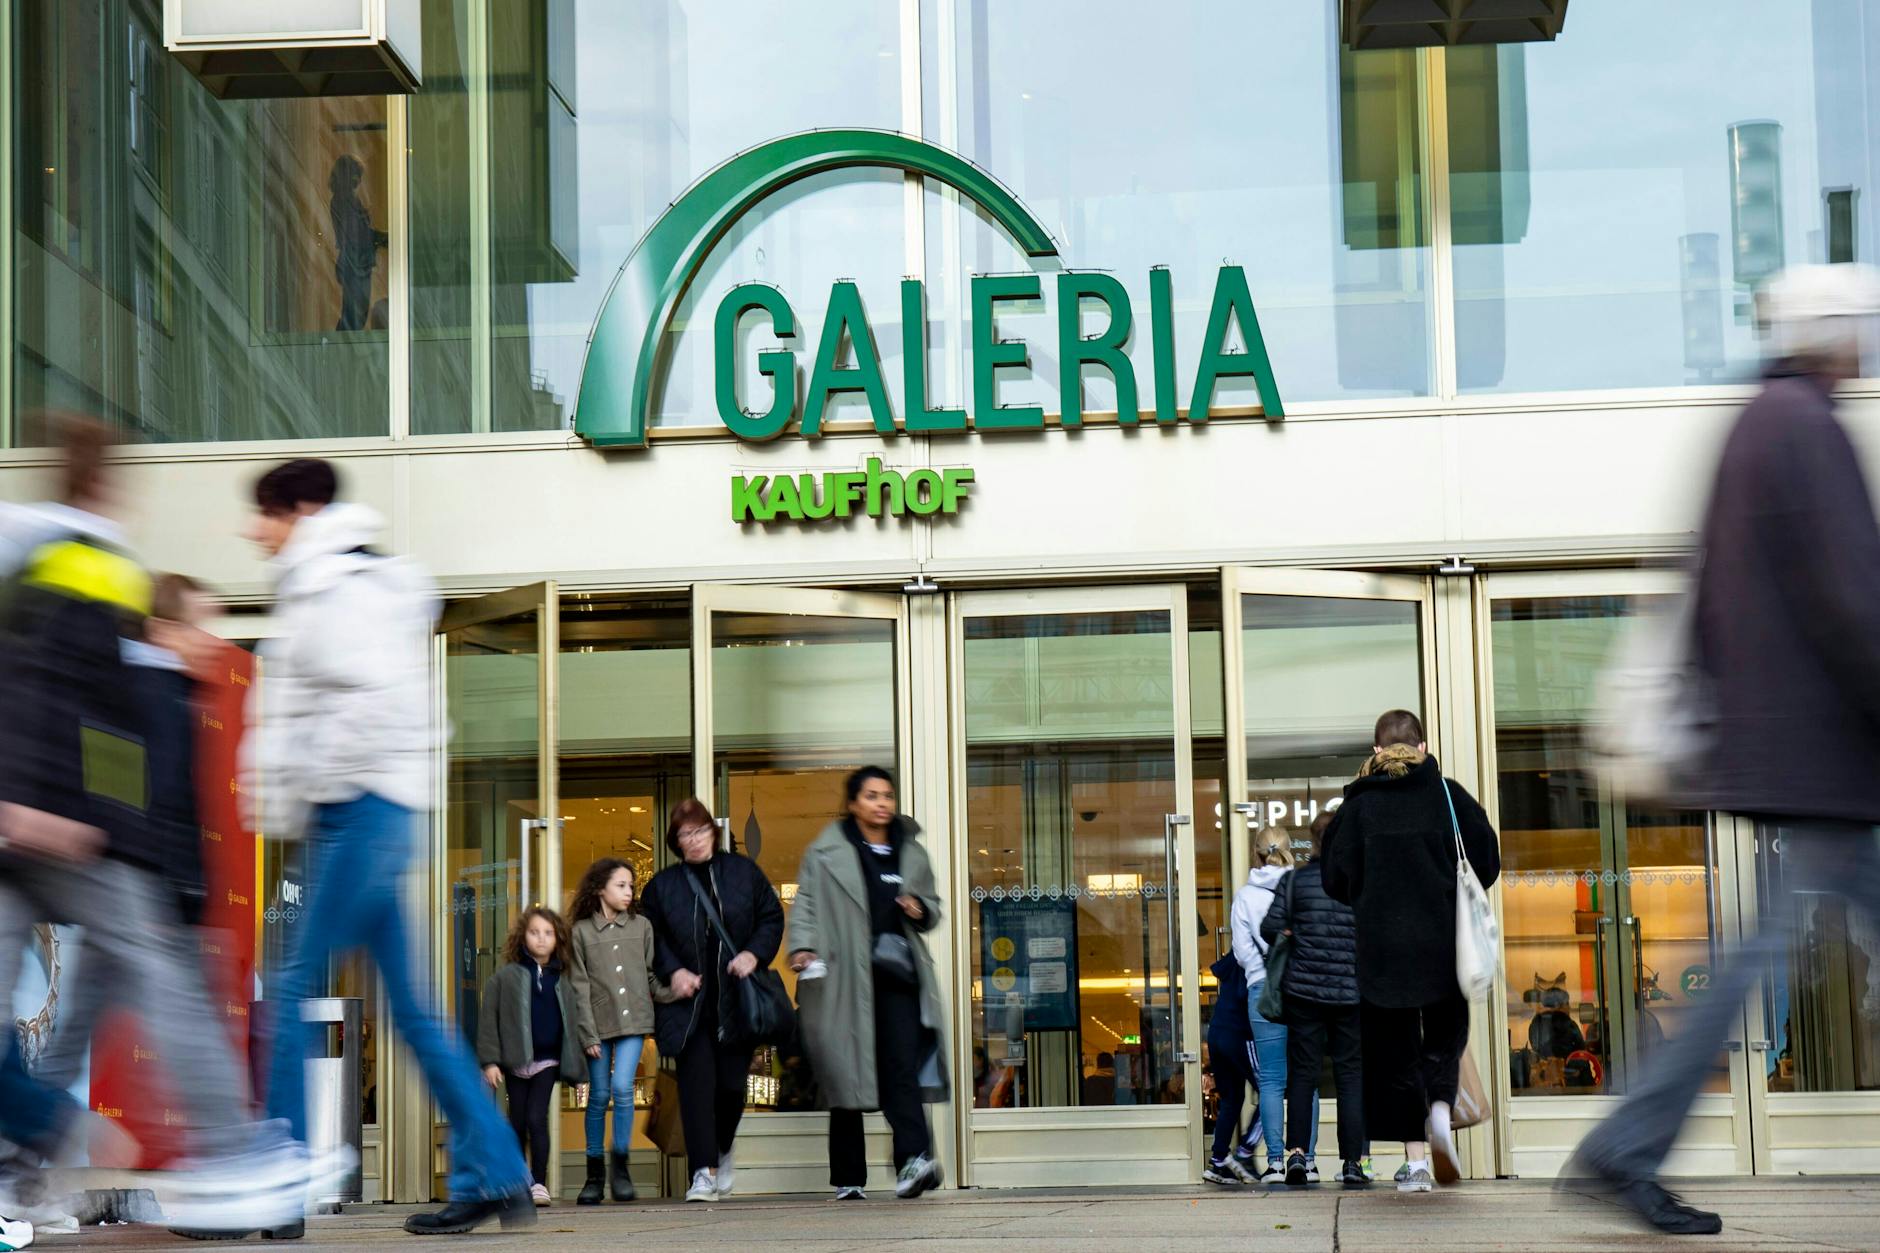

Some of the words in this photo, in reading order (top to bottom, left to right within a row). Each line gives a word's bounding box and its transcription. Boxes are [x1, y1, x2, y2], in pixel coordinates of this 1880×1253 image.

[714, 264, 1285, 442] GALERIA
[1687, 974, 1711, 990] 22
[103, 1107, 123, 1118] GALERIA
